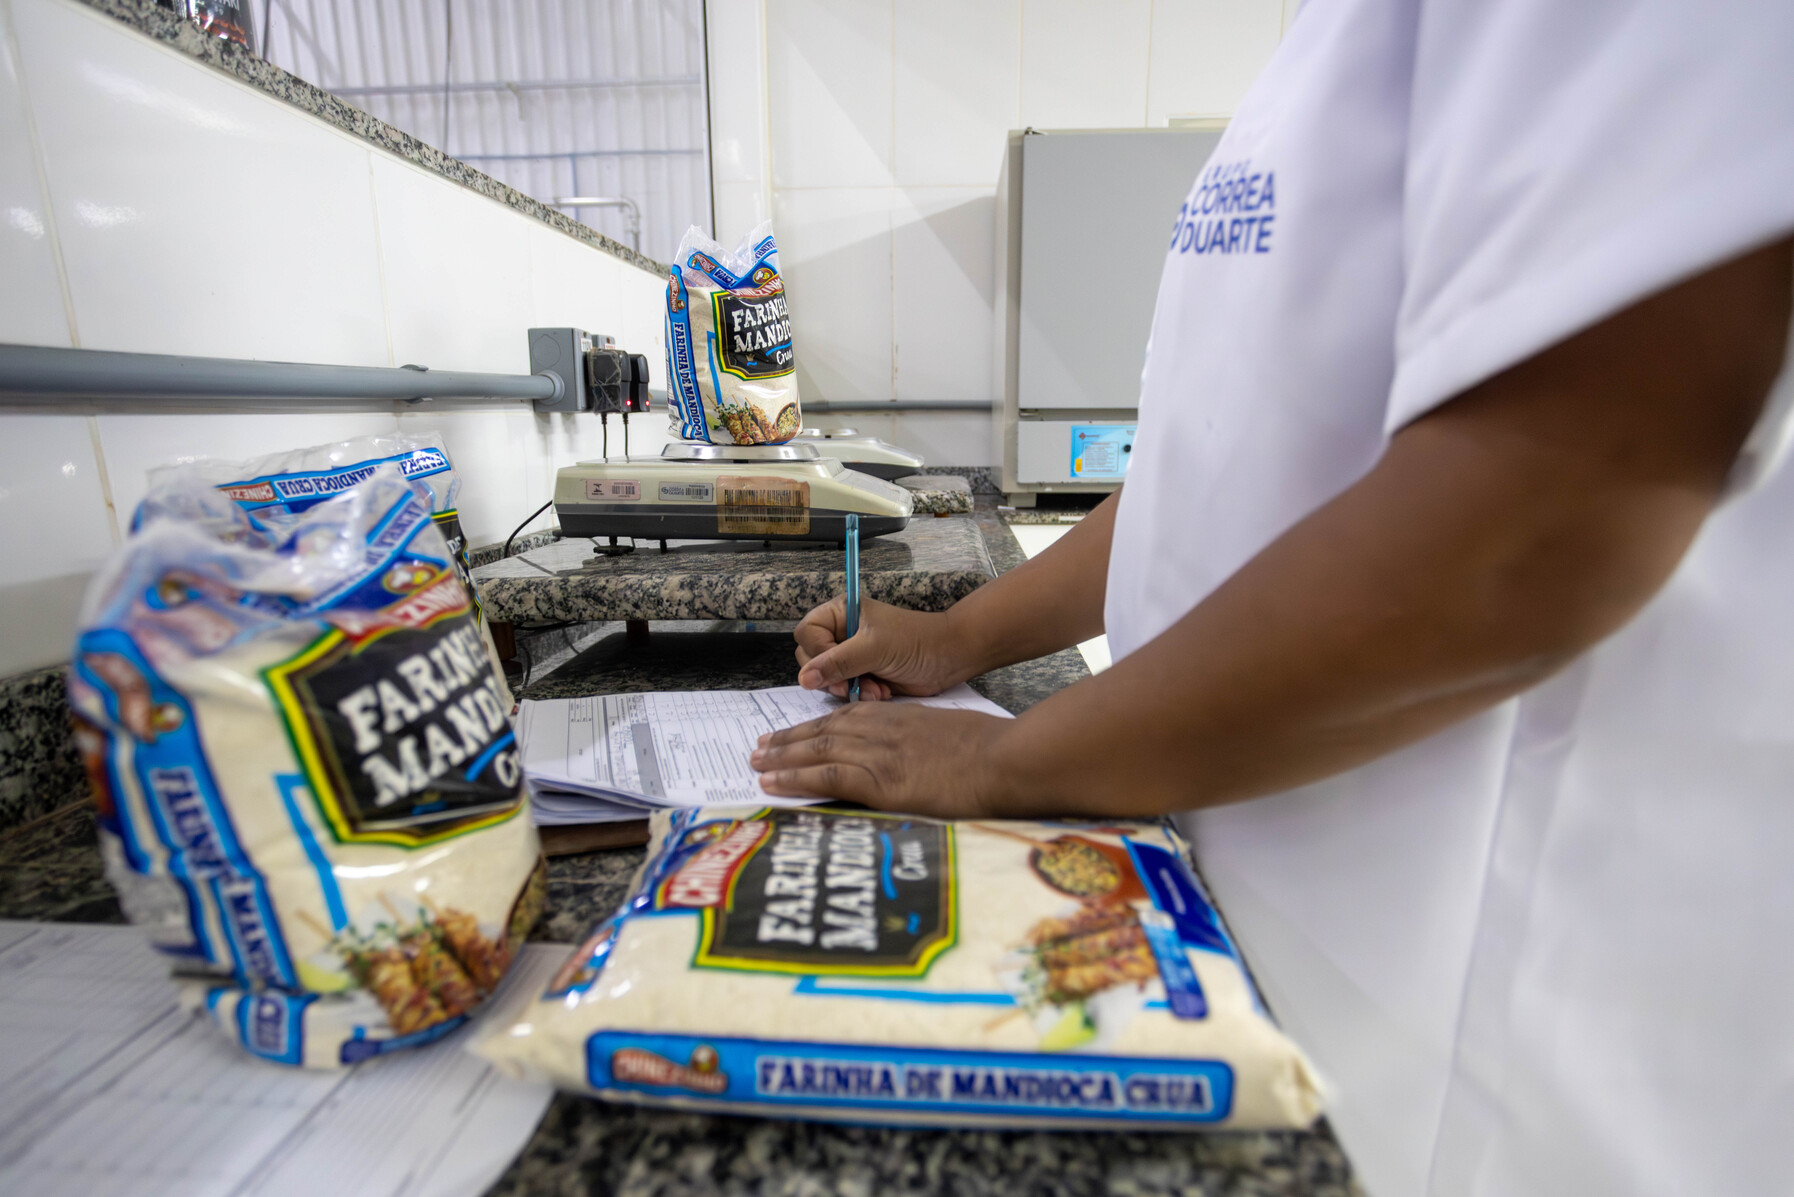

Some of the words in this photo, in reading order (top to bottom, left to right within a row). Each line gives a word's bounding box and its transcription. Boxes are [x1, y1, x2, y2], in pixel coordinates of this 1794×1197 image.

[1190, 172, 1275, 217] CORREA
[1180, 214, 1275, 254] DUARTE
[674, 324, 688, 369] FARINHA
[681, 372, 691, 384] DE
[277, 479, 314, 496] CRUA
[757, 825, 824, 945] FARINHA
[761, 1060, 896, 1097] FARINHA
[906, 1068, 942, 1097] DE
[952, 1071, 1116, 1105] MANDIOCA
[1126, 1078, 1206, 1110] CRUA
